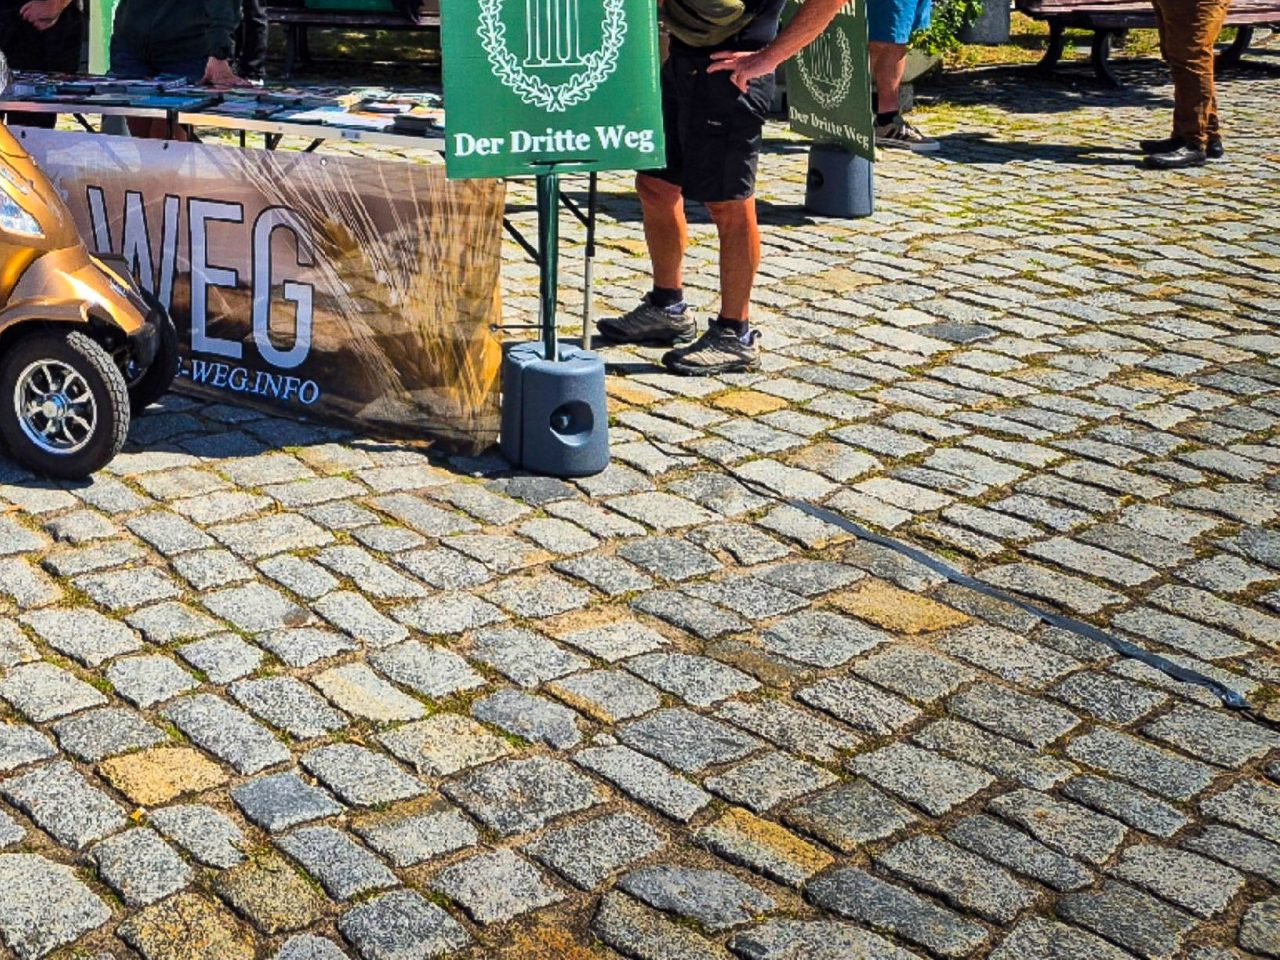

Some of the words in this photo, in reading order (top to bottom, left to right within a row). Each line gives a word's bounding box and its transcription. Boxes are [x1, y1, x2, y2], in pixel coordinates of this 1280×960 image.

[454, 132, 504, 157] Der
[510, 127, 591, 154] Dritte
[595, 124, 655, 153] Weg
[789, 106, 809, 125] Der
[842, 124, 870, 151] Weg
[86, 184, 316, 369] WEG
